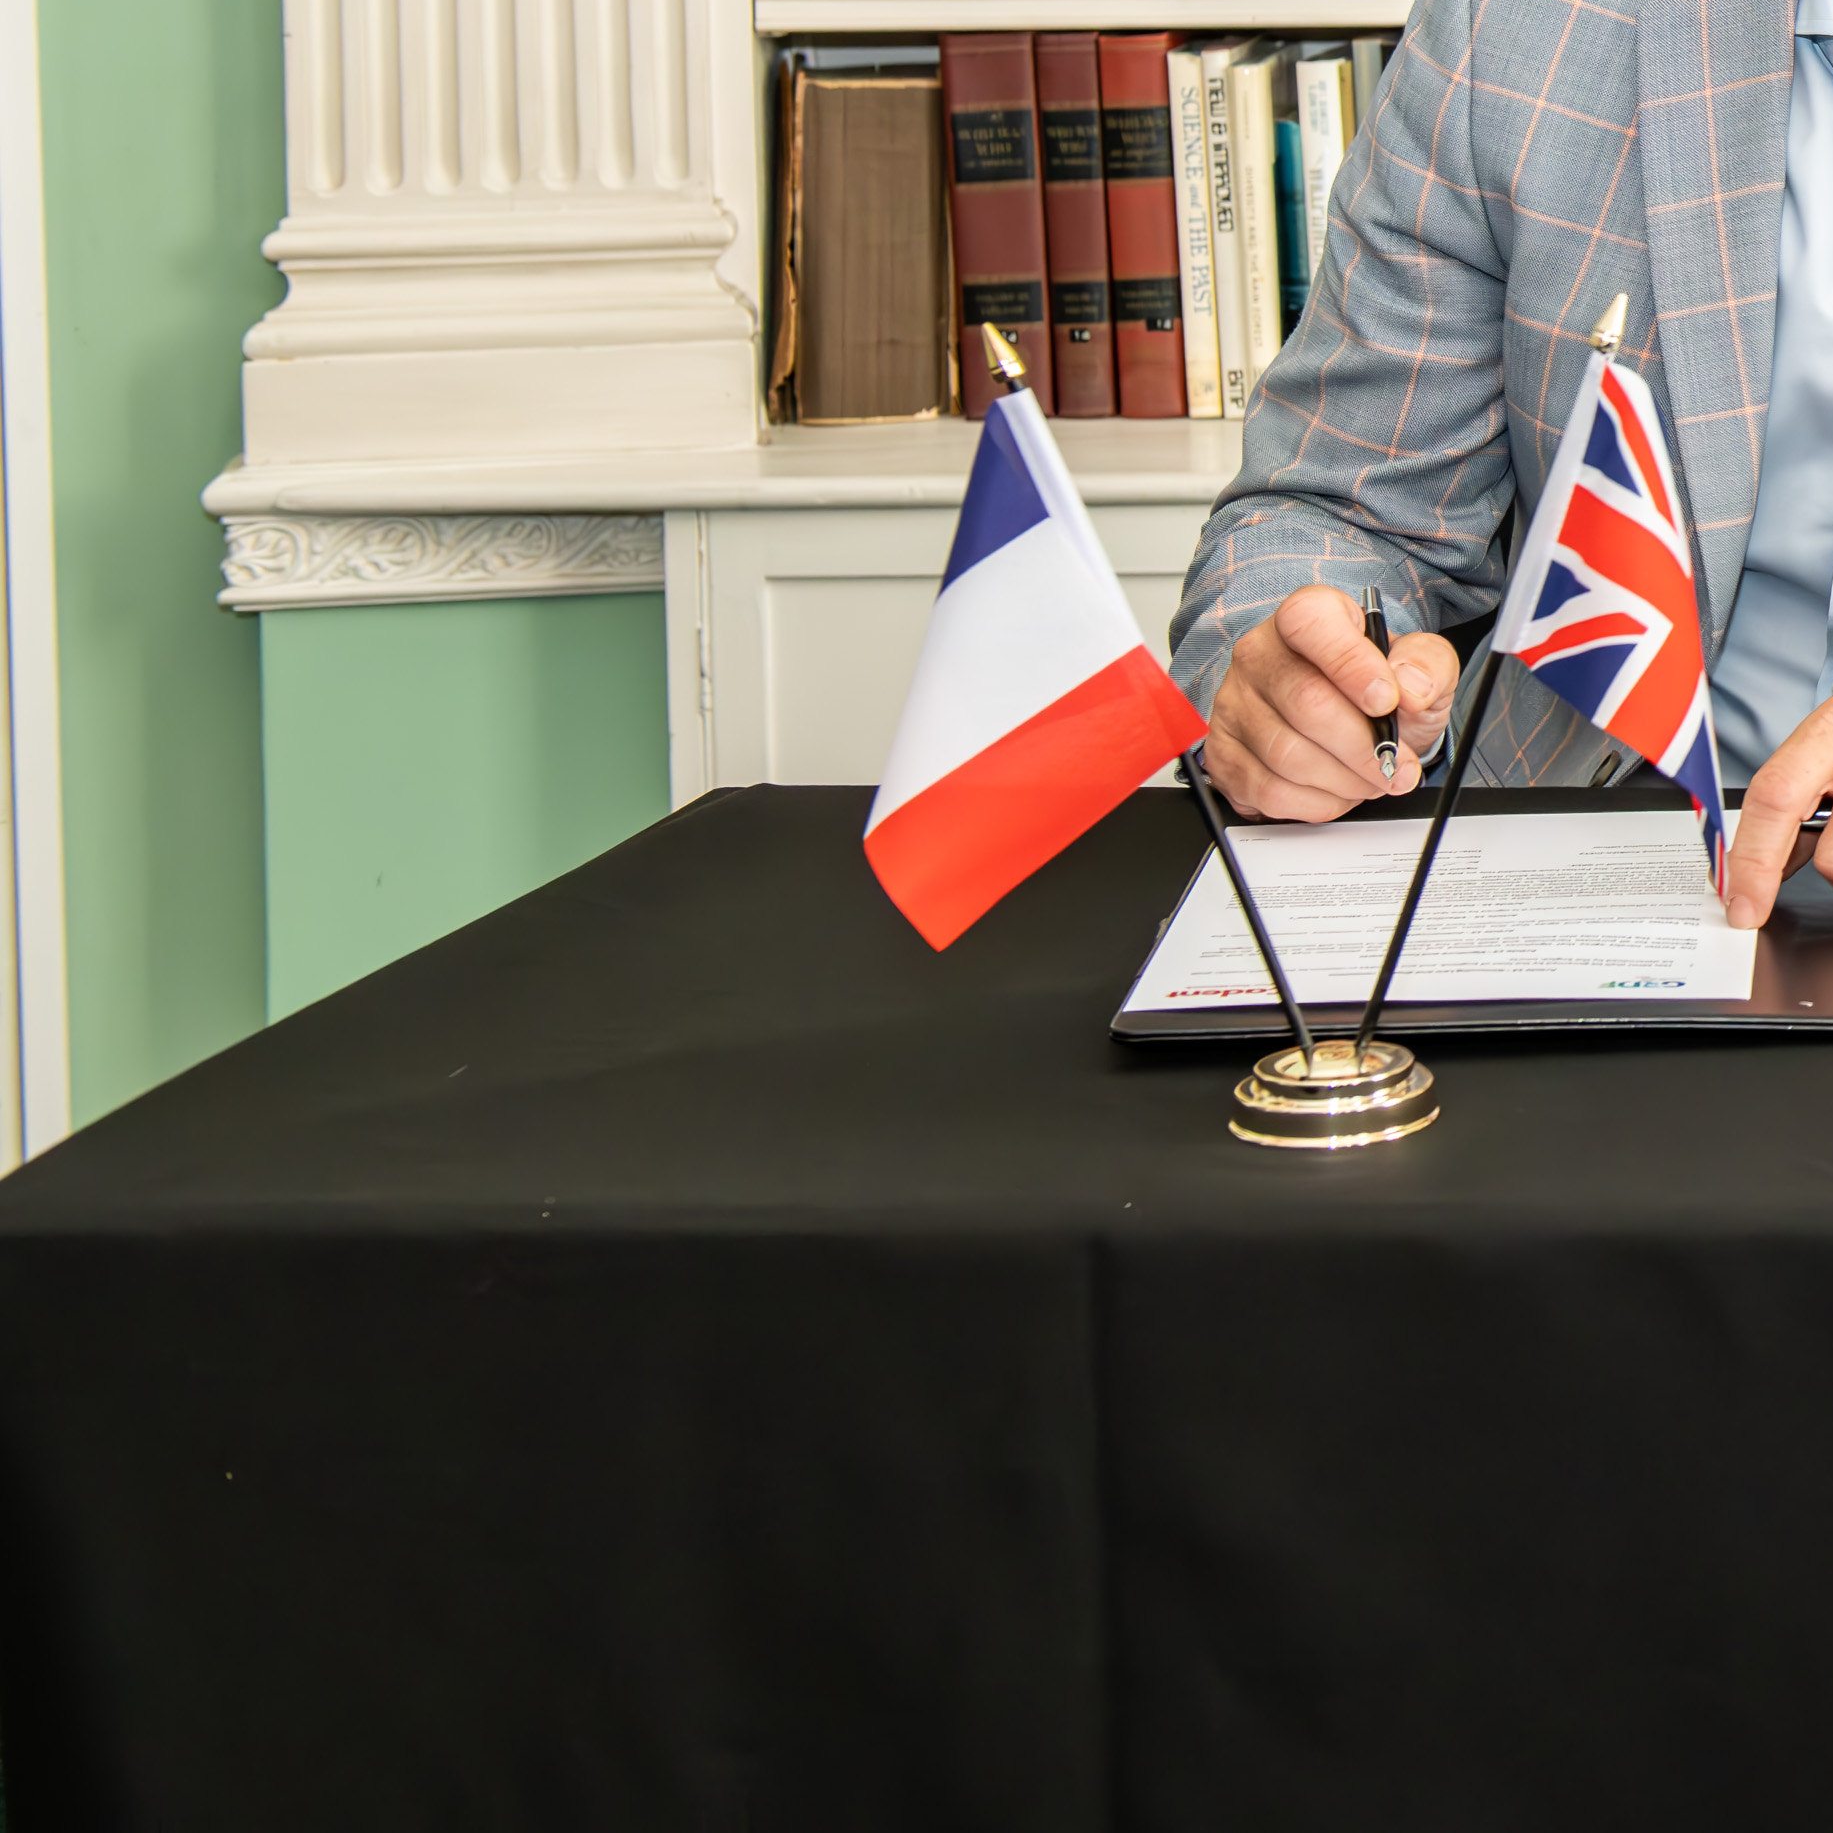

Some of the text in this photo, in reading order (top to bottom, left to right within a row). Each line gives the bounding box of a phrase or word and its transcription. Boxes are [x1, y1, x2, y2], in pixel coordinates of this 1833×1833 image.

[1180, 86, 1205, 179] SCIENCE
[1188, 212, 1209, 257] THE
[1191, 266, 1213, 317] PAST
[1598, 980, 1687, 989] GRDF
